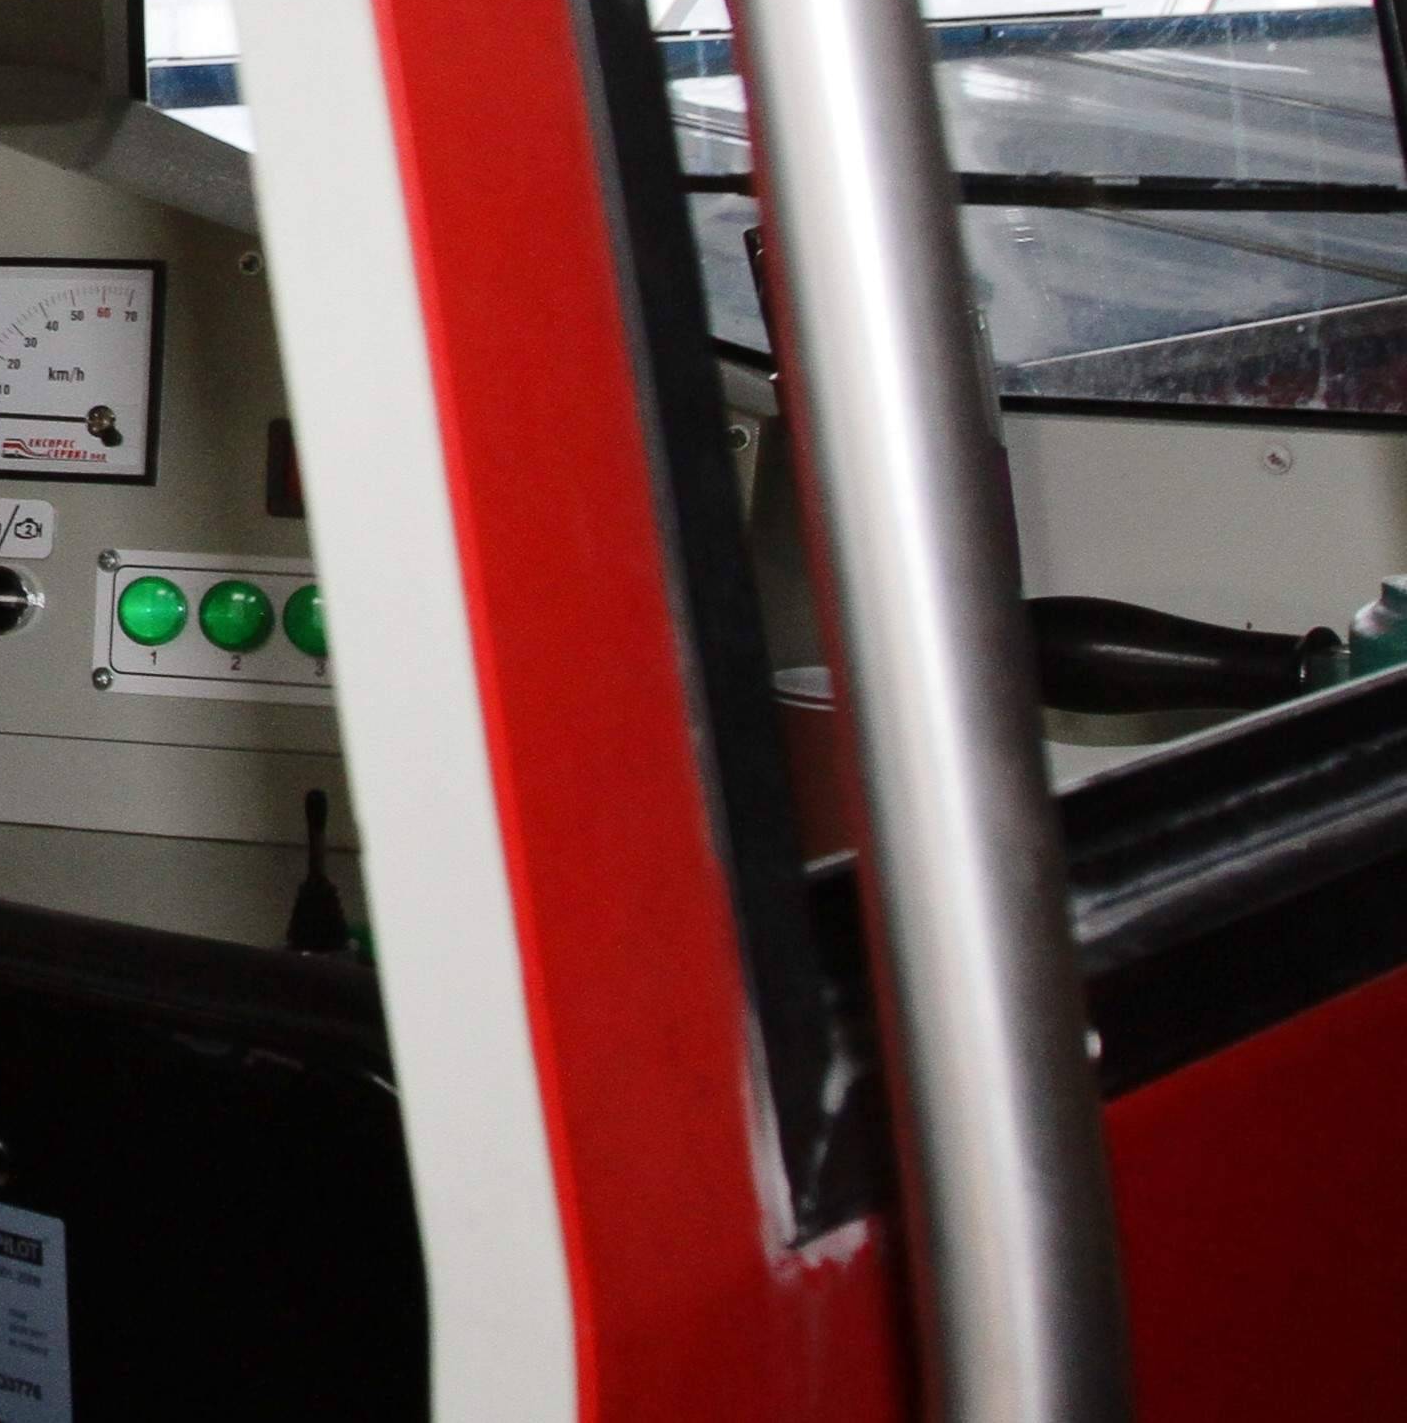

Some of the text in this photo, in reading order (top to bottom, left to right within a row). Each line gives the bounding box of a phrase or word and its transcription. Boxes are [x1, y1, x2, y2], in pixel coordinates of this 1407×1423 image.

[70, 310, 85, 321] 50
[97, 307, 111, 318] 60
[124, 311, 138, 322] 70
[45, 321, 59, 331] 40
[24, 337, 37, 348] 30
[7, 359, 21, 369] 20
[48, 367, 85, 382] km/h
[25, 525, 32, 536] 2
[150, 651, 157, 665] 1
[231, 656, 241, 670] 2
